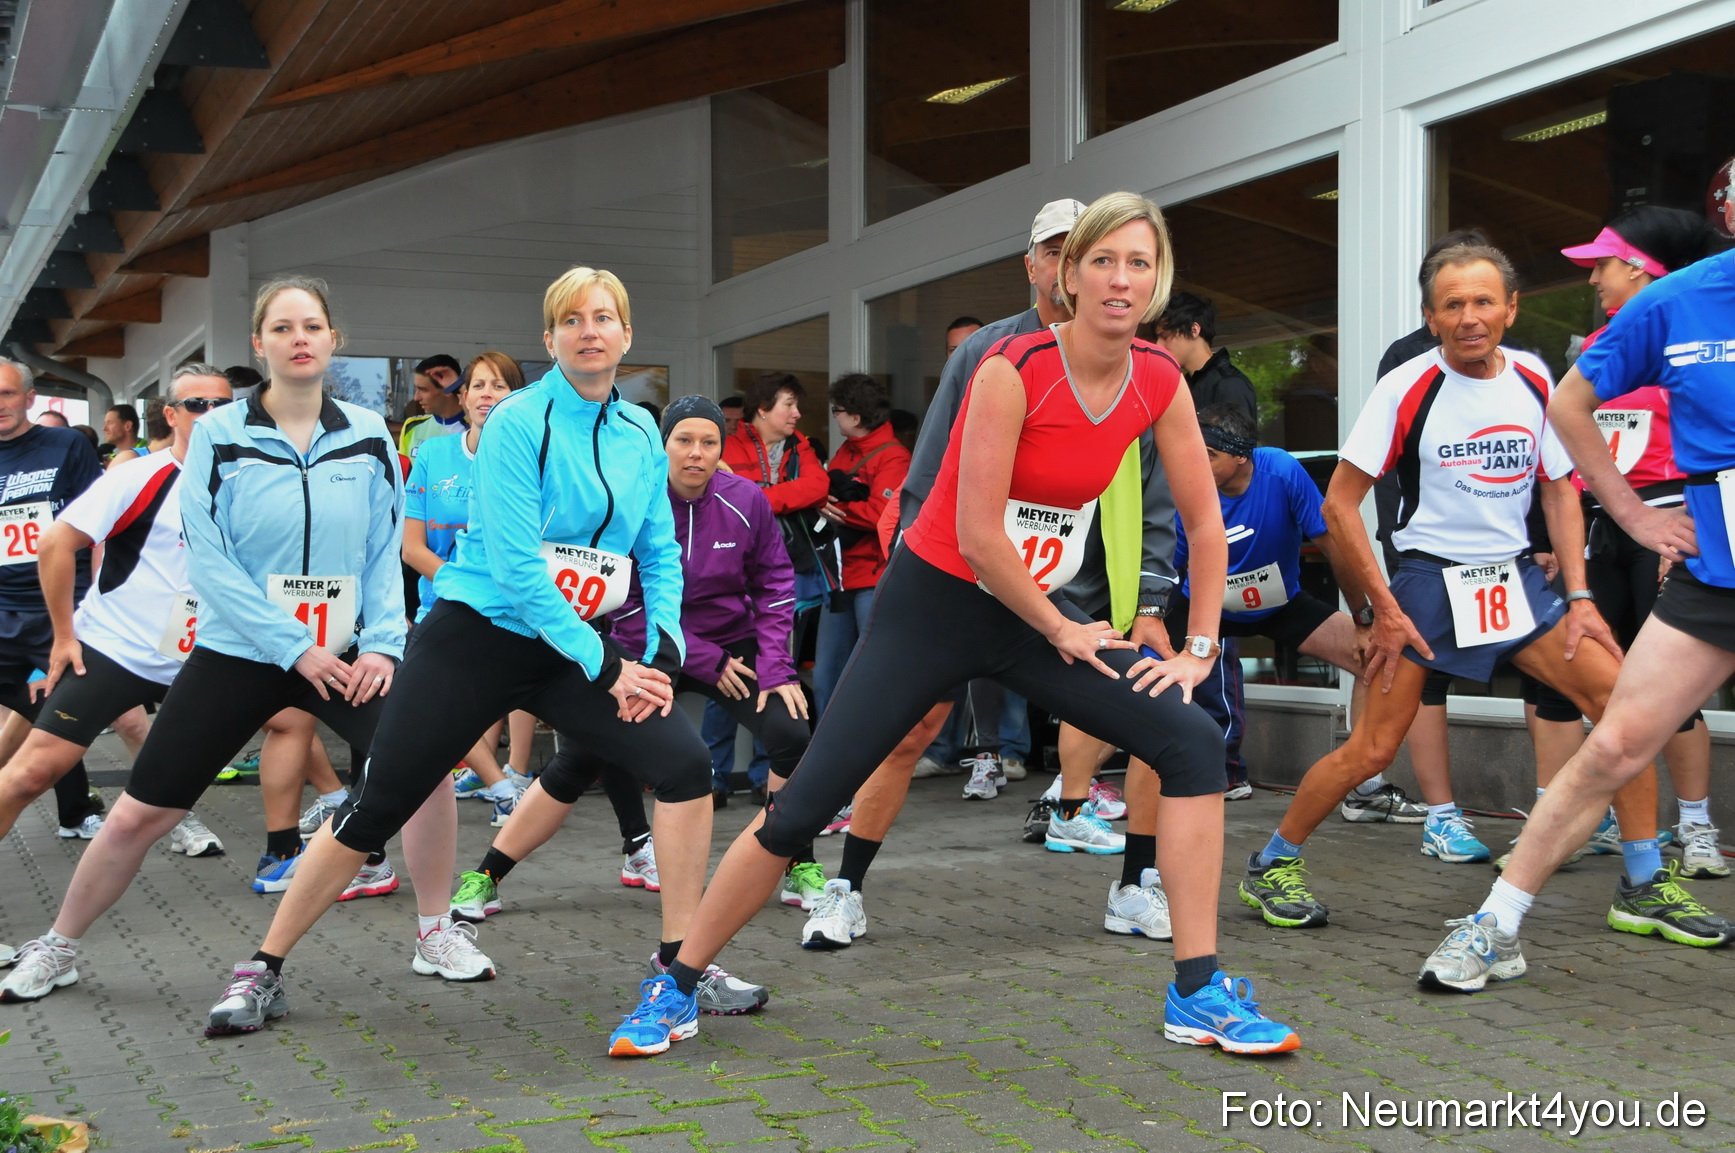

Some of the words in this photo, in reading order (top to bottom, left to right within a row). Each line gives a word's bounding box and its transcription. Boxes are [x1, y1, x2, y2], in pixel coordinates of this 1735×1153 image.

[1597, 413, 1625, 422] MEYER
[1438, 438, 1527, 458] GERHART
[1440, 458, 1483, 468] Autohaus
[6, 468, 59, 488] Wagner
[1454, 480, 1472, 494] Das
[1472, 488, 1510, 499] sportliche
[1017, 506, 1060, 525] MEYER
[1016, 519, 1059, 533] WERBUNG
[4, 522, 40, 557] 26
[555, 546, 599, 563] MEYER
[555, 553, 598, 571] WERBUNG
[1022, 535, 1063, 592] 12
[1226, 573, 1256, 587] MEYER
[1460, 566, 1496, 580] MEYER
[1461, 576, 1498, 586] WERBUNG
[283, 579, 324, 590] MEYER
[283, 589, 325, 598] WERBUNG
[555, 568, 607, 622] 69
[1242, 586, 1262, 609] 9
[1474, 585, 1511, 634] 18
